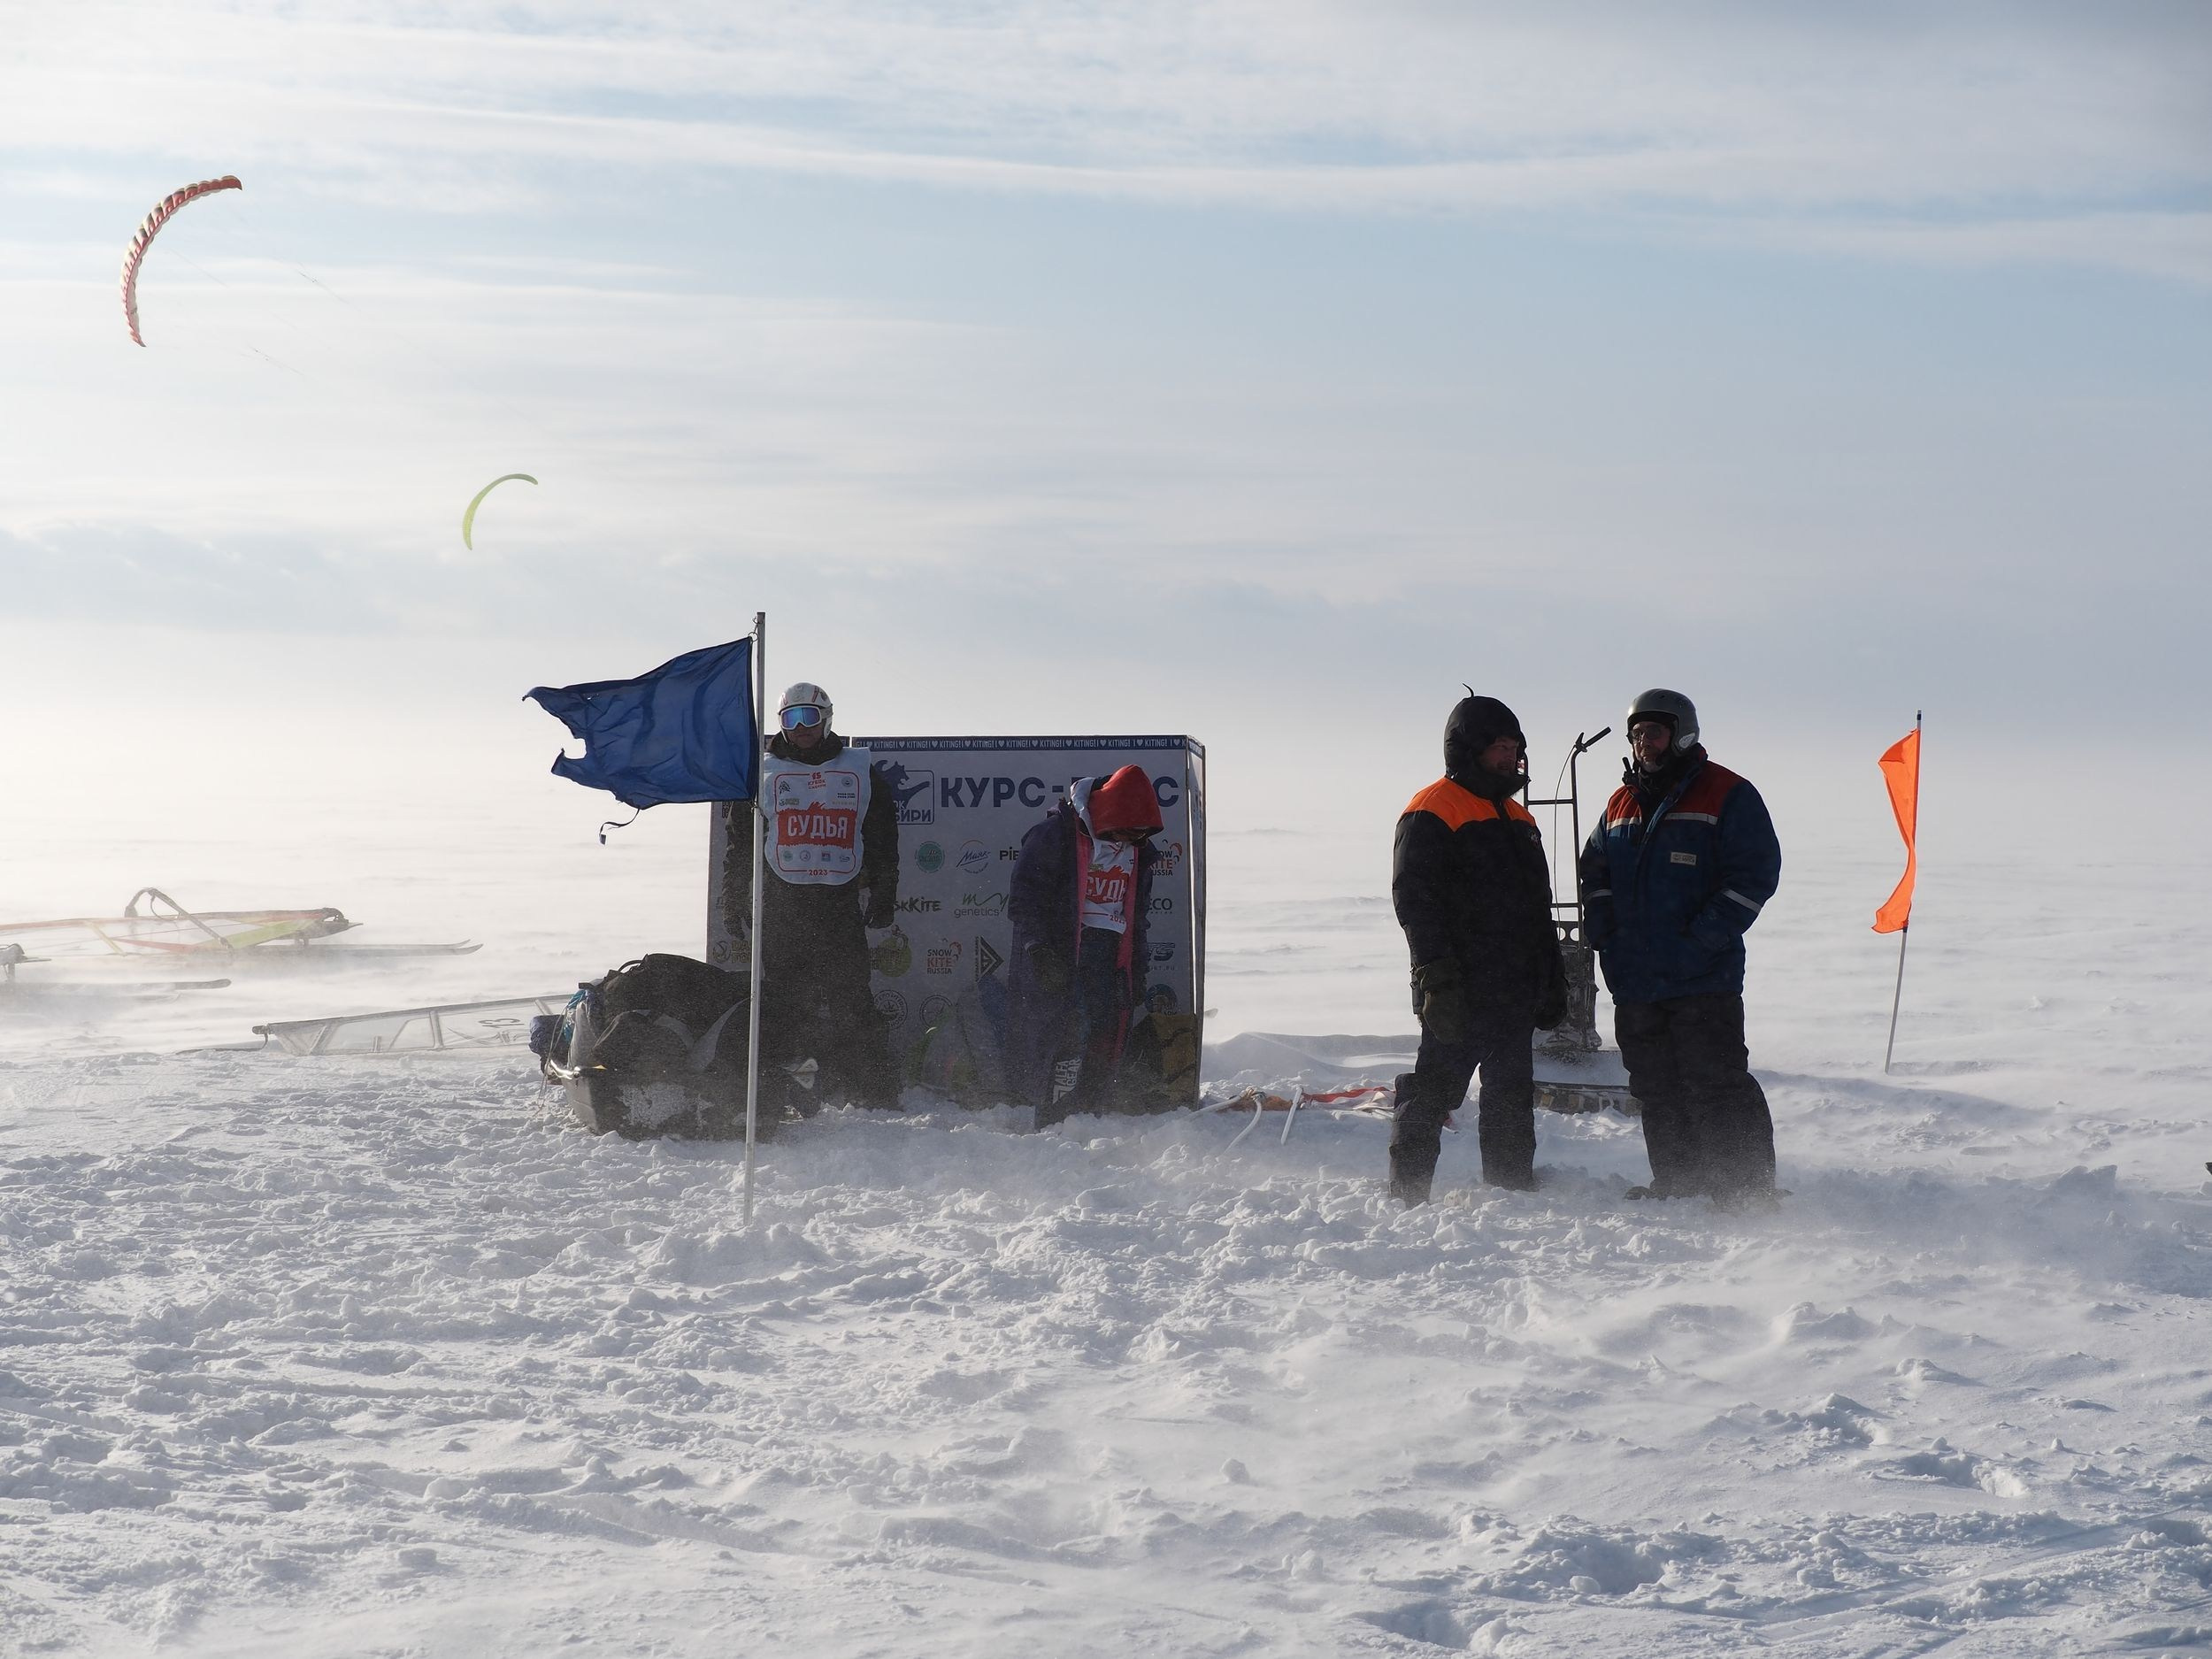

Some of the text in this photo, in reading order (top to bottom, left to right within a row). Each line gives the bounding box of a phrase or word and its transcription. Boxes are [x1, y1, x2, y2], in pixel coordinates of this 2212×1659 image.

[787, 814, 848, 839] СУДЬЯ
[1152, 859, 1173, 869] ITE
[1086, 876, 1125, 902] СУДЬ
[954, 908, 1000, 918] genetics
[927, 957, 953, 967] KITE
